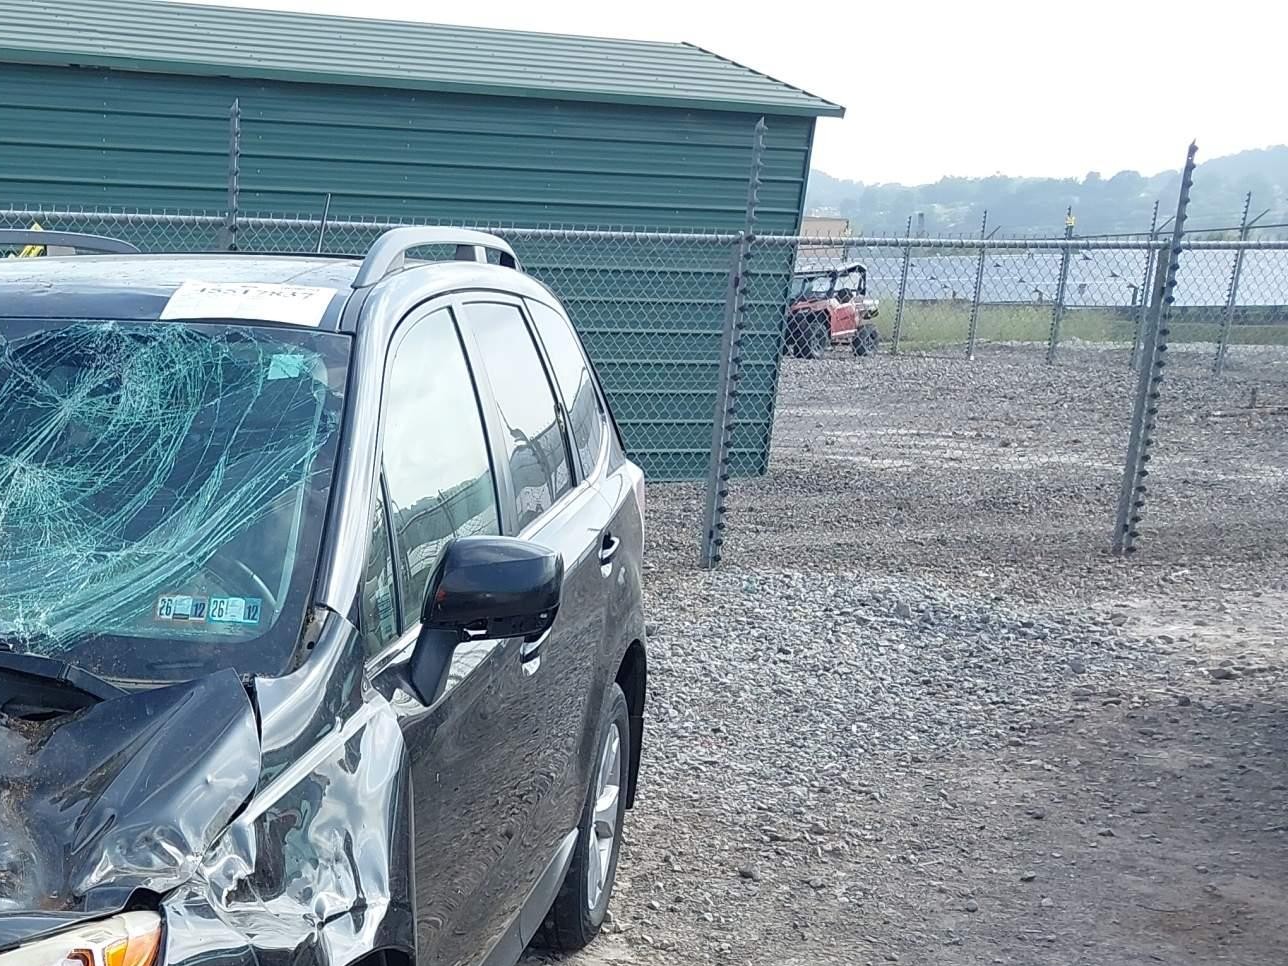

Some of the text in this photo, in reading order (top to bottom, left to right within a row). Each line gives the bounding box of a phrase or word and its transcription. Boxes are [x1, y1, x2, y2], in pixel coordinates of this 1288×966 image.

[159, 598, 206, 618] 26 12
[211, 600, 259, 620] 26 12
